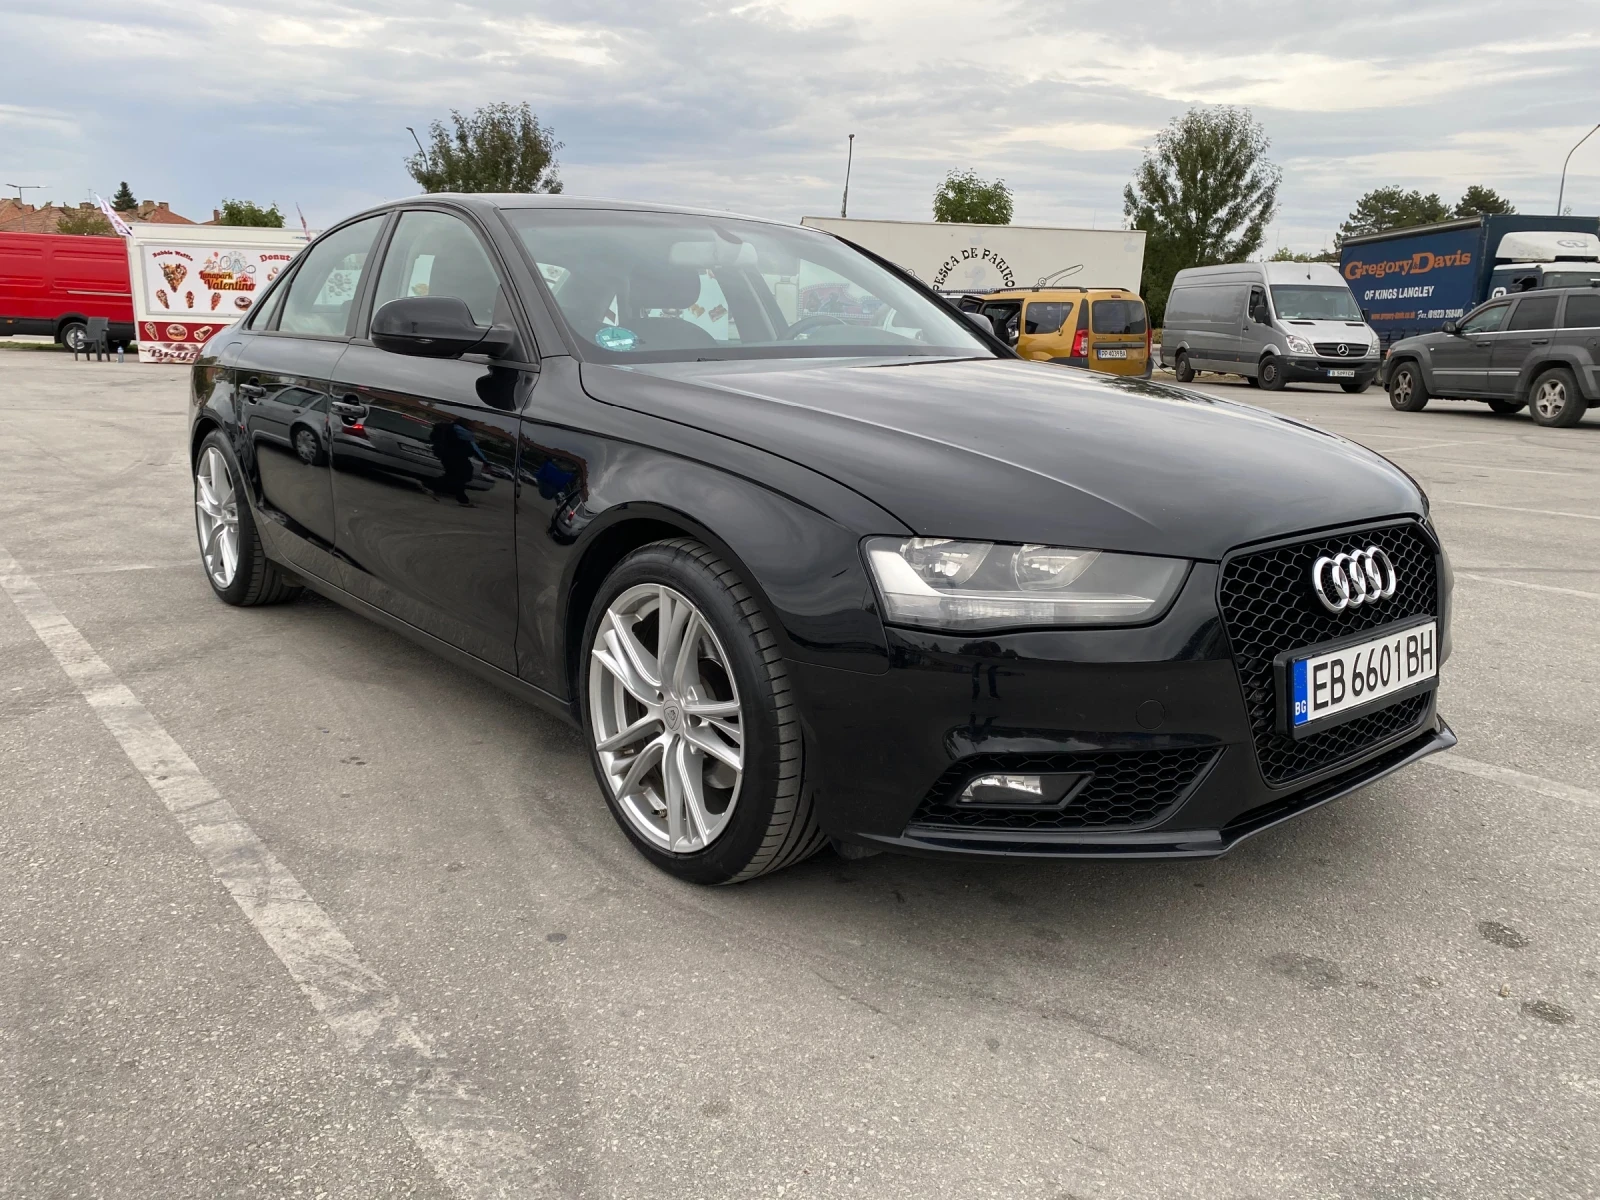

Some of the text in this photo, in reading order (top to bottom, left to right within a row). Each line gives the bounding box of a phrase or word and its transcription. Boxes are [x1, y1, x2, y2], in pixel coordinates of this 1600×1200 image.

[260, 253, 293, 262] Donut
[961, 247, 978, 260] DE
[1344, 260, 1412, 280] Gregory
[1410, 250, 1471, 274] Davis
[204, 280, 256, 291] Valentino
[1364, 285, 1435, 300] OF KINGS LANGLEY
[1313, 629, 1433, 711] EB 6601 BH
[1295, 700, 1307, 716] BG
